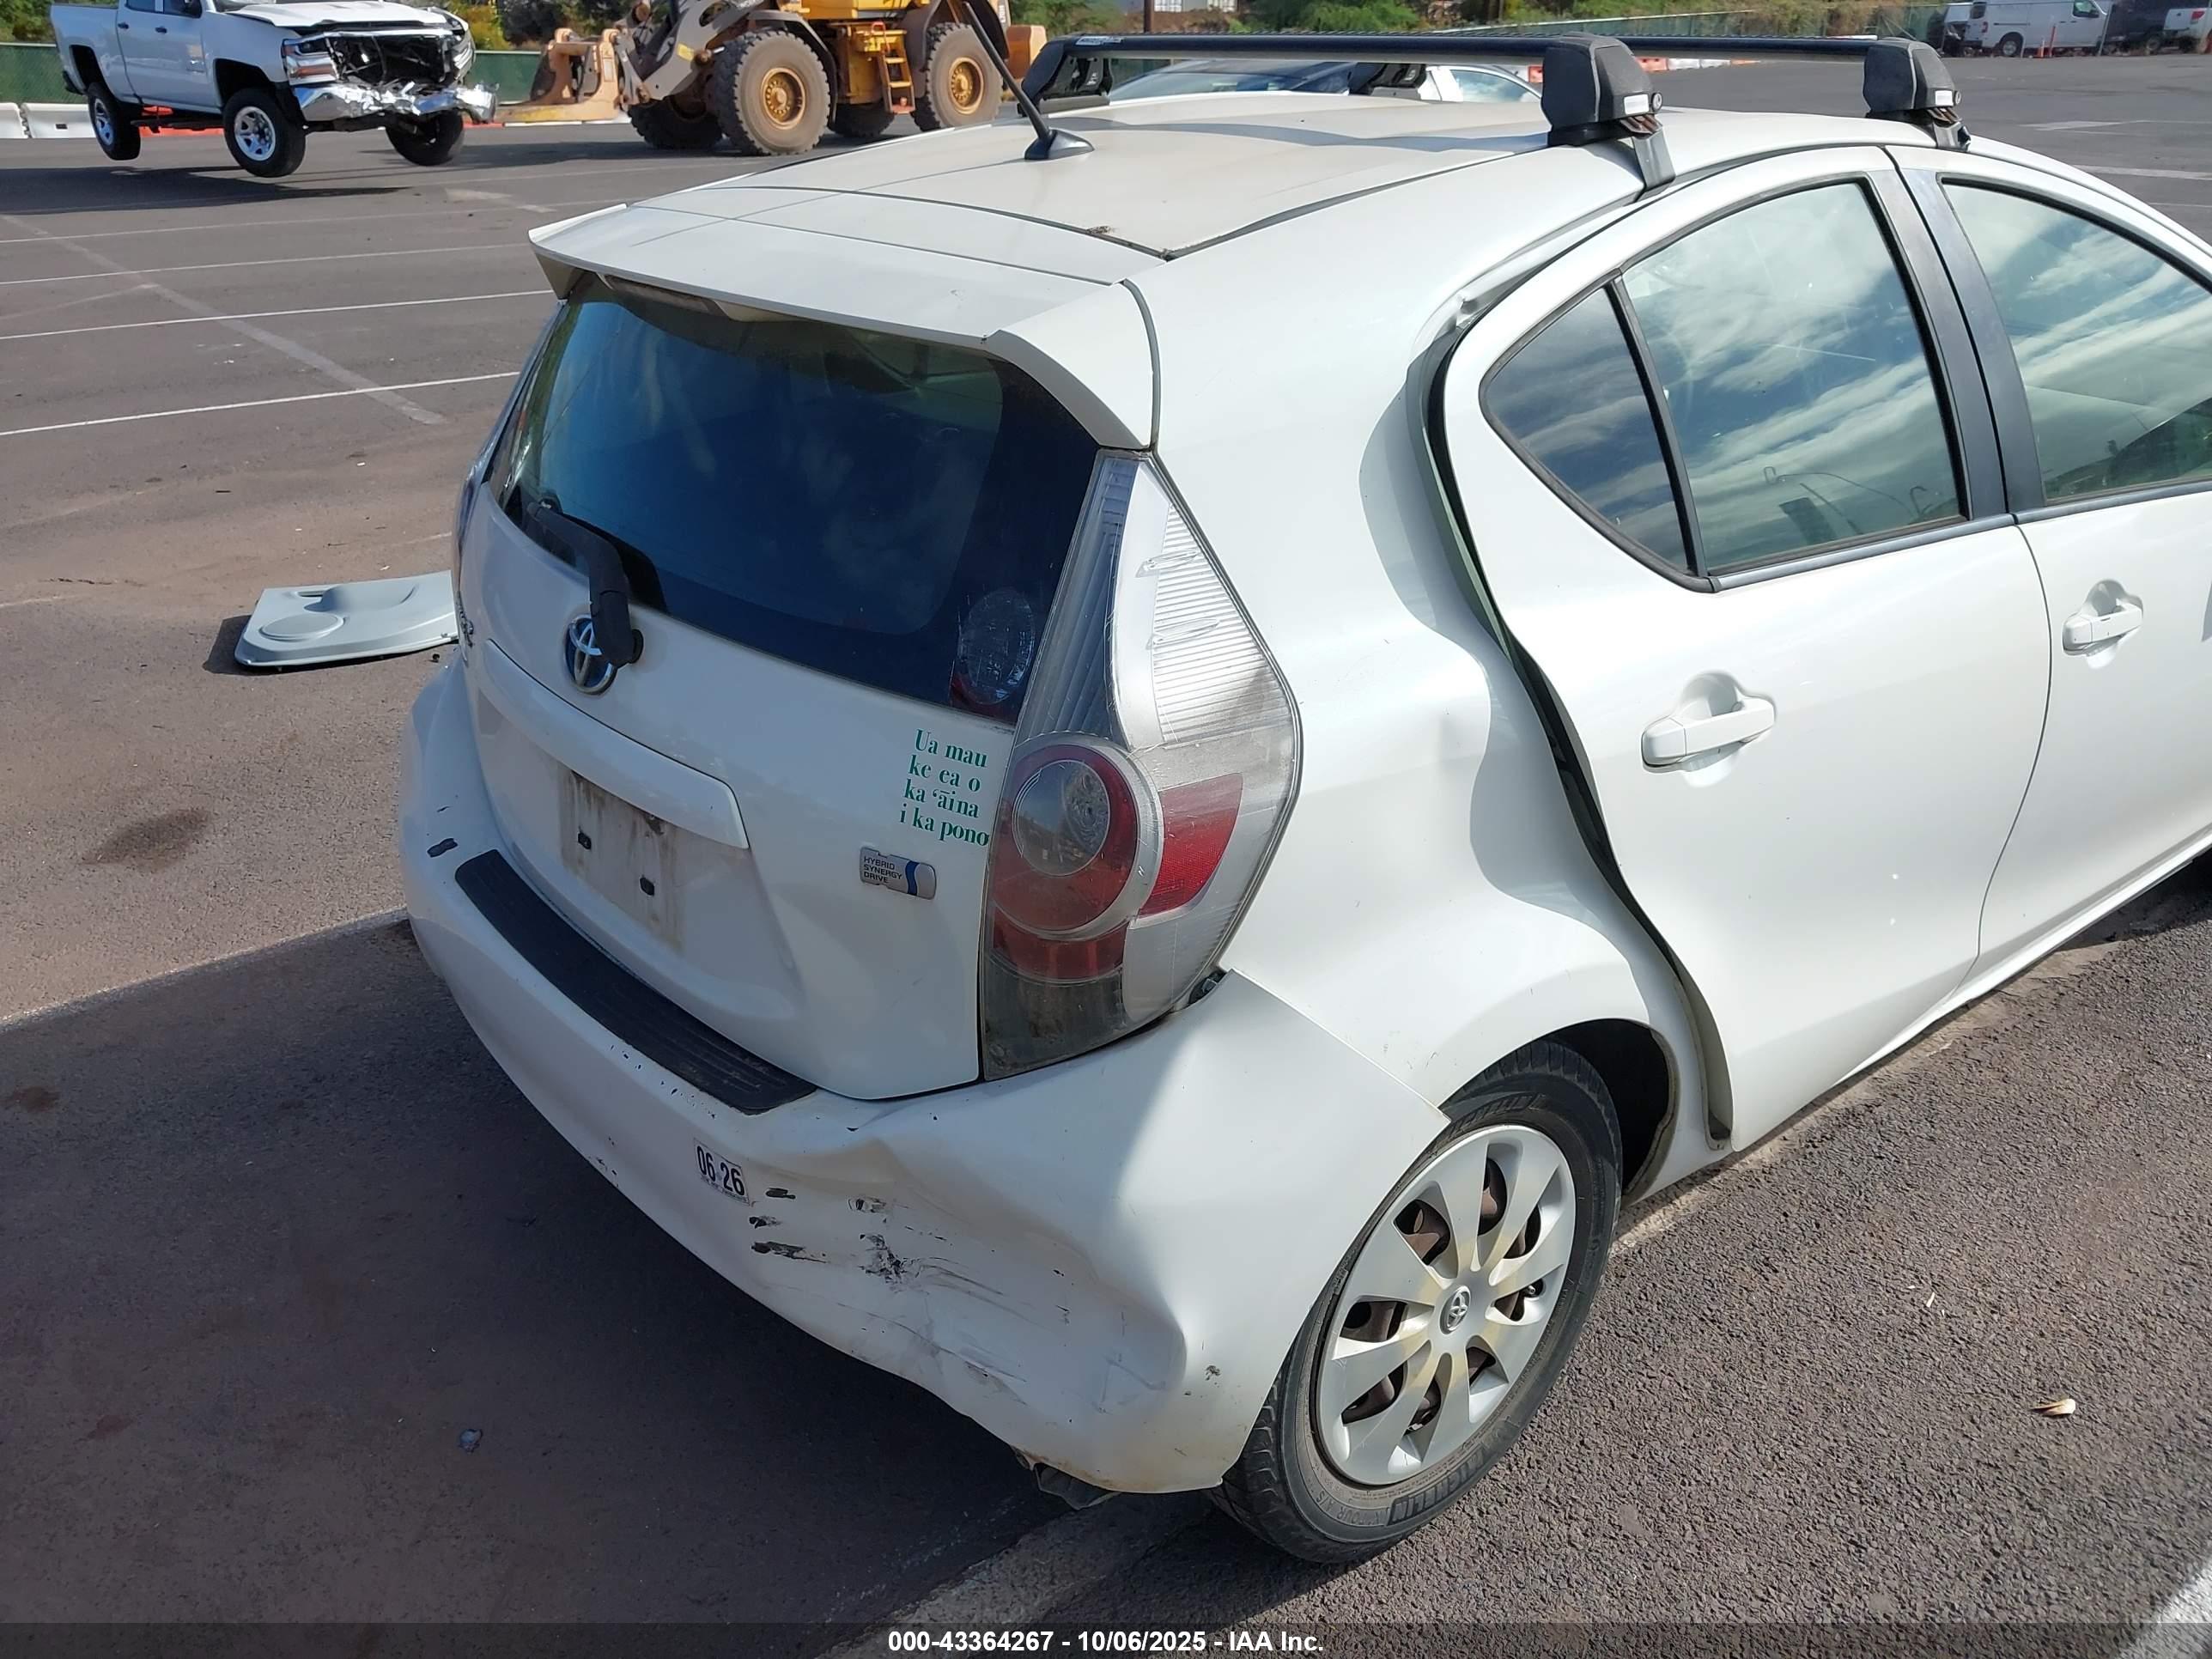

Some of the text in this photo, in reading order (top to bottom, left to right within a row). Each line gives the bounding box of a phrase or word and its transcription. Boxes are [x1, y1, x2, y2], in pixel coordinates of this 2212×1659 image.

[915, 729, 988, 768] Ua mau
[908, 754, 981, 793] ke ea o
[904, 779, 926, 803] ka
[900, 803, 989, 847] i ka pono
[864, 856, 896, 870] HYBRID
[864, 864, 902, 879] SYNERGY
[864, 871, 890, 883] DRIVE
[696, 1145, 716, 1182] 06
[720, 1162, 745, 1196] 26
